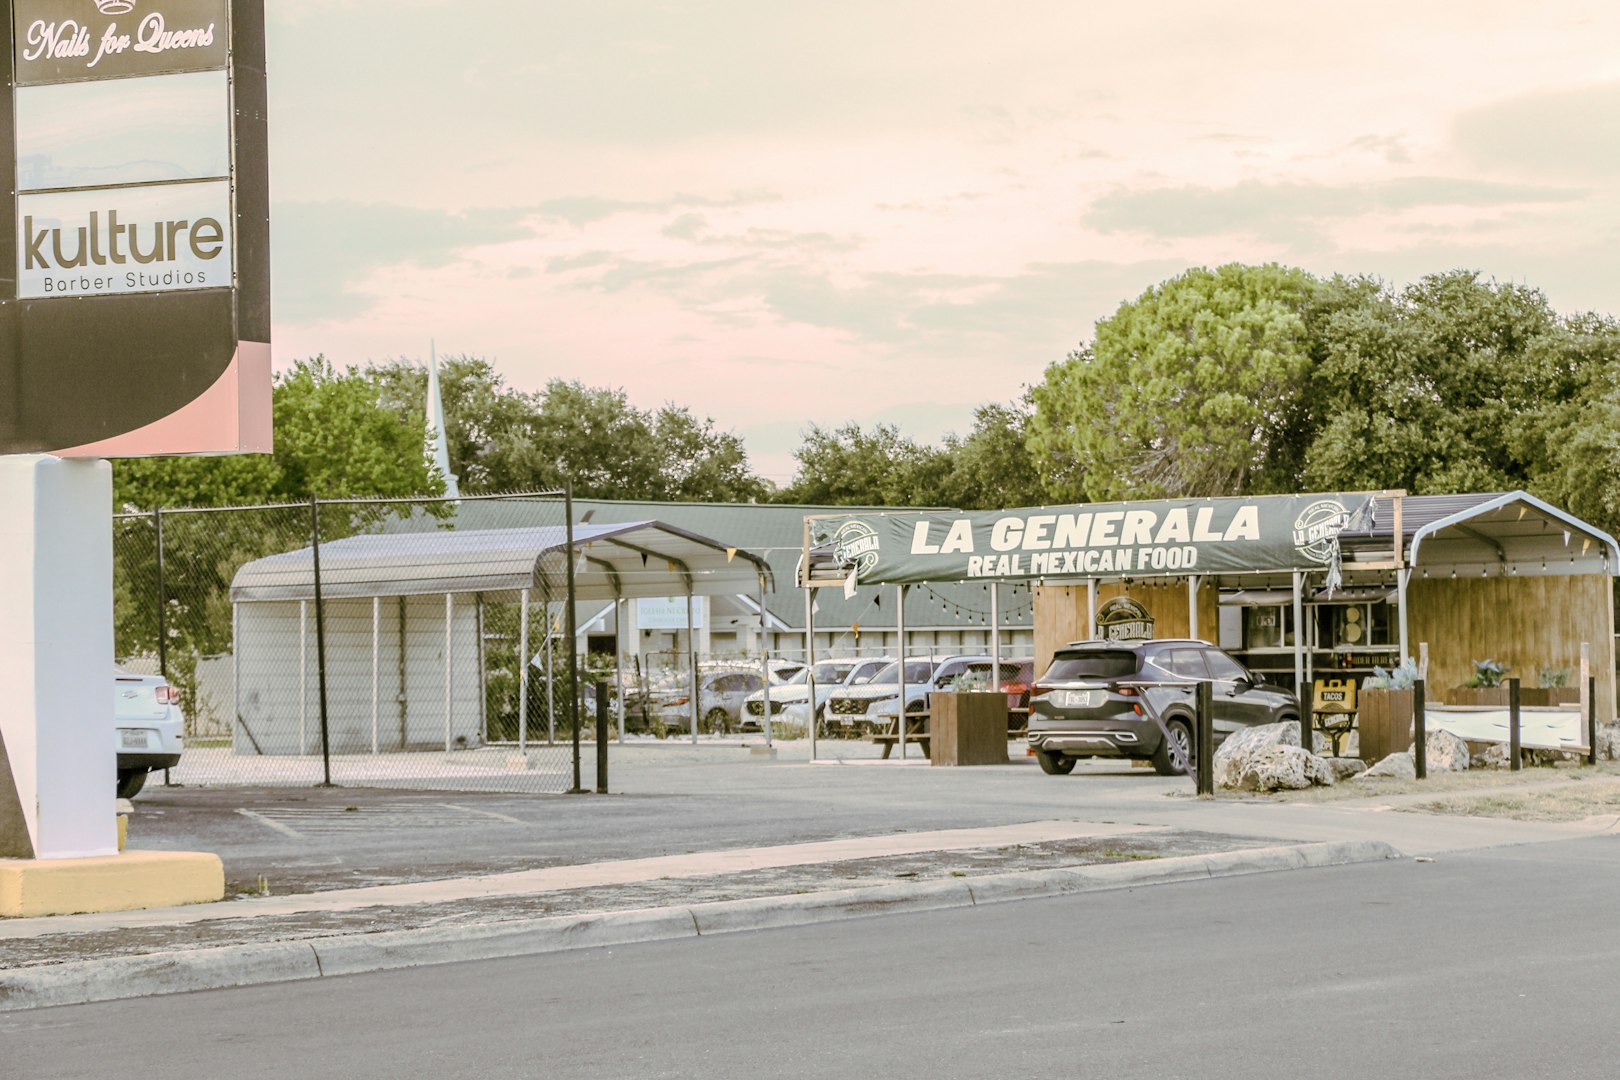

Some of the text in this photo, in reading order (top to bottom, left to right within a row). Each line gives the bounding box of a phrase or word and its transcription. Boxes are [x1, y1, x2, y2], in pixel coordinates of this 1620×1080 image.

[23, 12, 215, 67] Nails for Queens
[24, 210, 224, 270] kulture
[44, 270, 207, 293] Barber Studios
[910, 505, 1261, 555] LA GENERALA
[1292, 530, 1306, 546] LA
[967, 545, 1198, 578] REAL MEXICAN FOOD
[1108, 621, 1153, 640] GENERALA
[1323, 692, 1343, 701] TACOS
